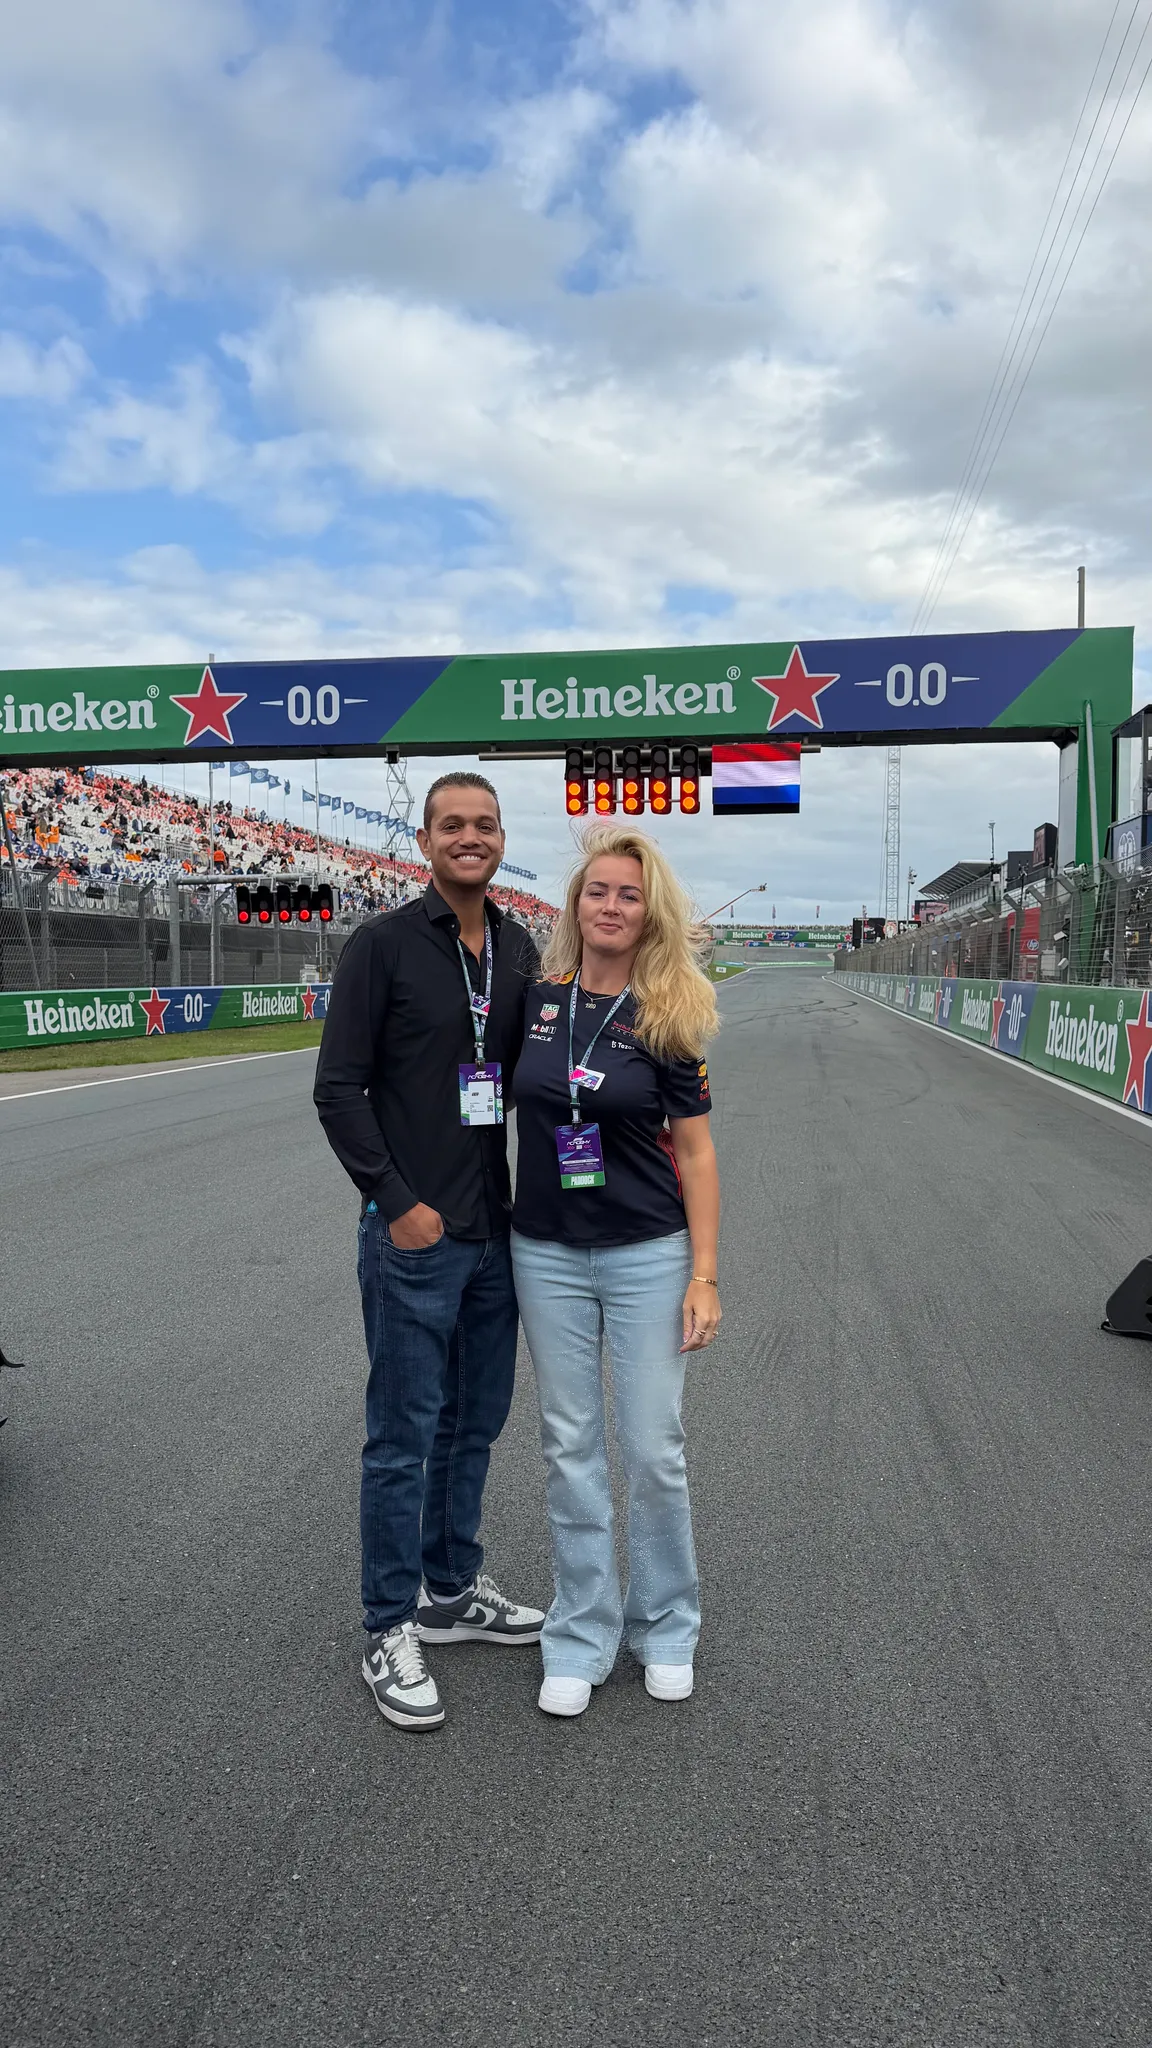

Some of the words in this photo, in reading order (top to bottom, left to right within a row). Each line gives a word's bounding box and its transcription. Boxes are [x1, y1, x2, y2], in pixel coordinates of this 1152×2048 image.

[501, 675, 737, 720] Heineken
[887, 662, 947, 706] 0.0
[0, 692, 157, 733] ineken
[288, 685, 340, 725] 0.0
[24, 997, 135, 1035] Heineken
[184, 993, 203, 1023] 0.0
[242, 991, 298, 1018] Heineken
[1045, 1000, 1118, 1075] Heineken
